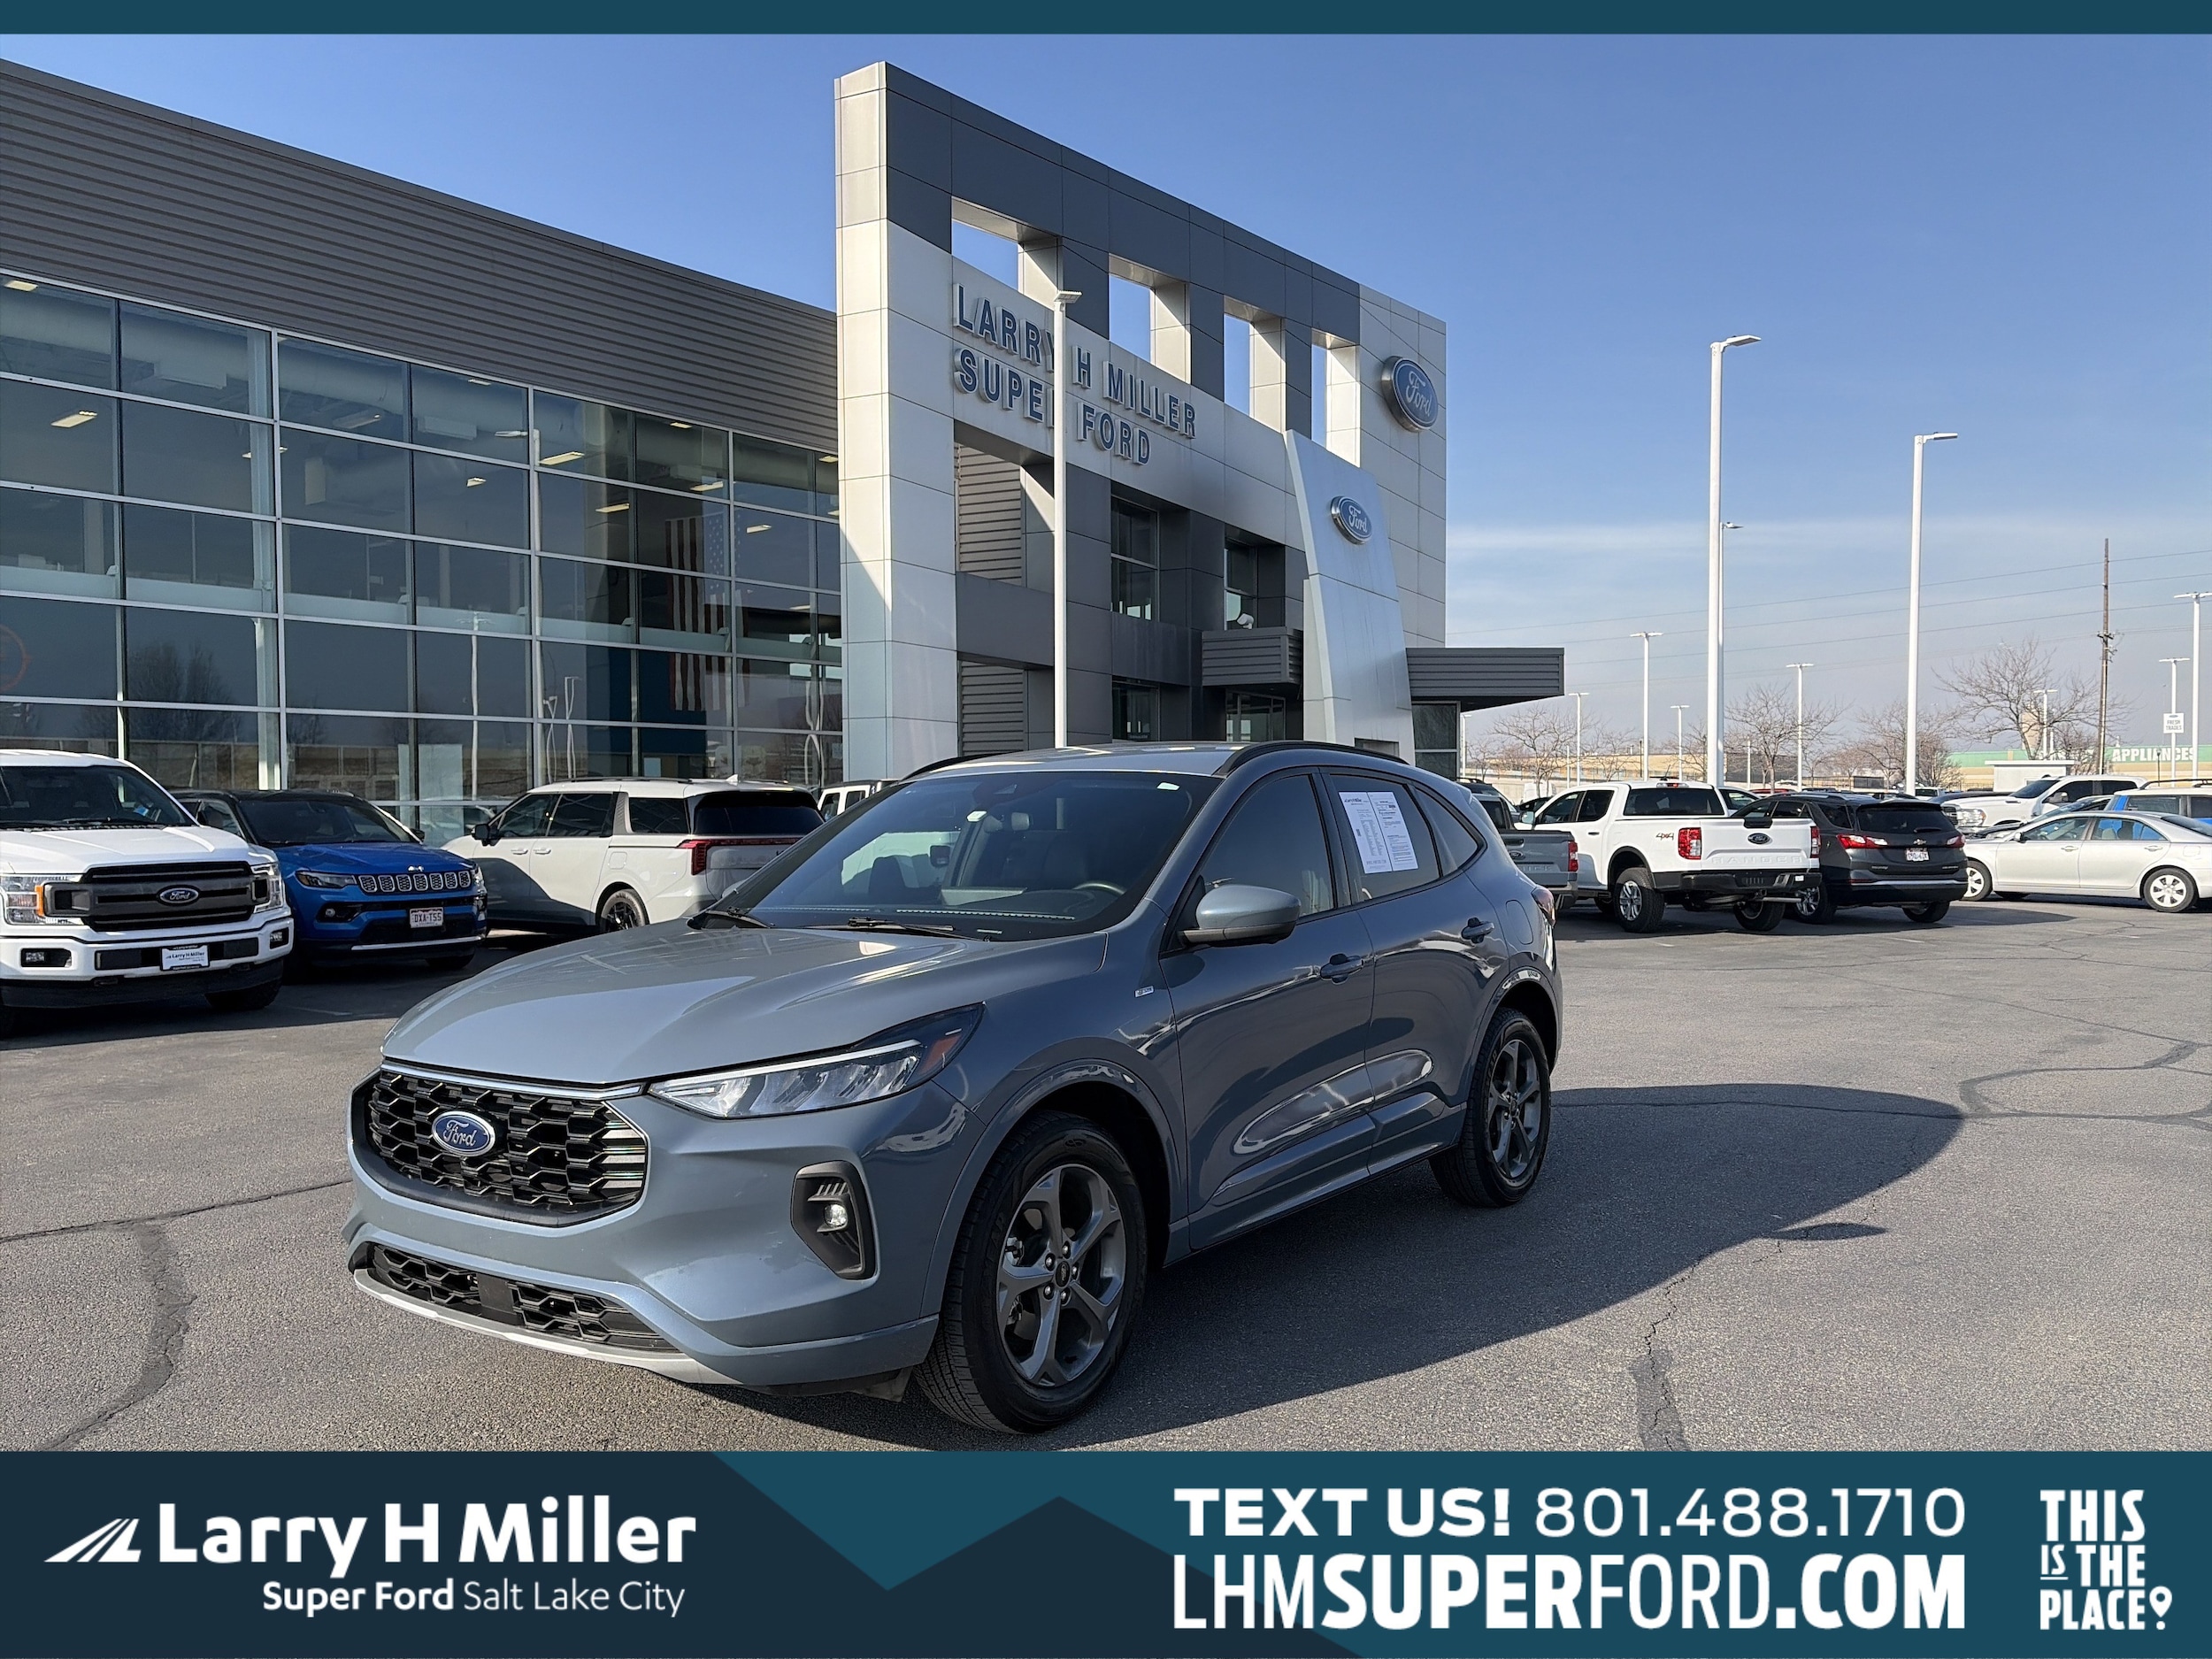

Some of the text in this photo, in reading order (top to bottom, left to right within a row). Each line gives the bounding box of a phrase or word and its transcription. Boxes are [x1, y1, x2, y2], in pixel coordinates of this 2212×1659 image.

[953, 347, 1151, 466] SUPE FORD
[1072, 345, 1093, 389] H
[1102, 360, 1197, 440] MILLER
[1405, 370, 1432, 417] Ford
[1348, 504, 1368, 533] Ford
[1711, 856, 1803, 864] RANGER
[169, 890, 191, 901] Ford
[442, 1119, 478, 1147] Ford
